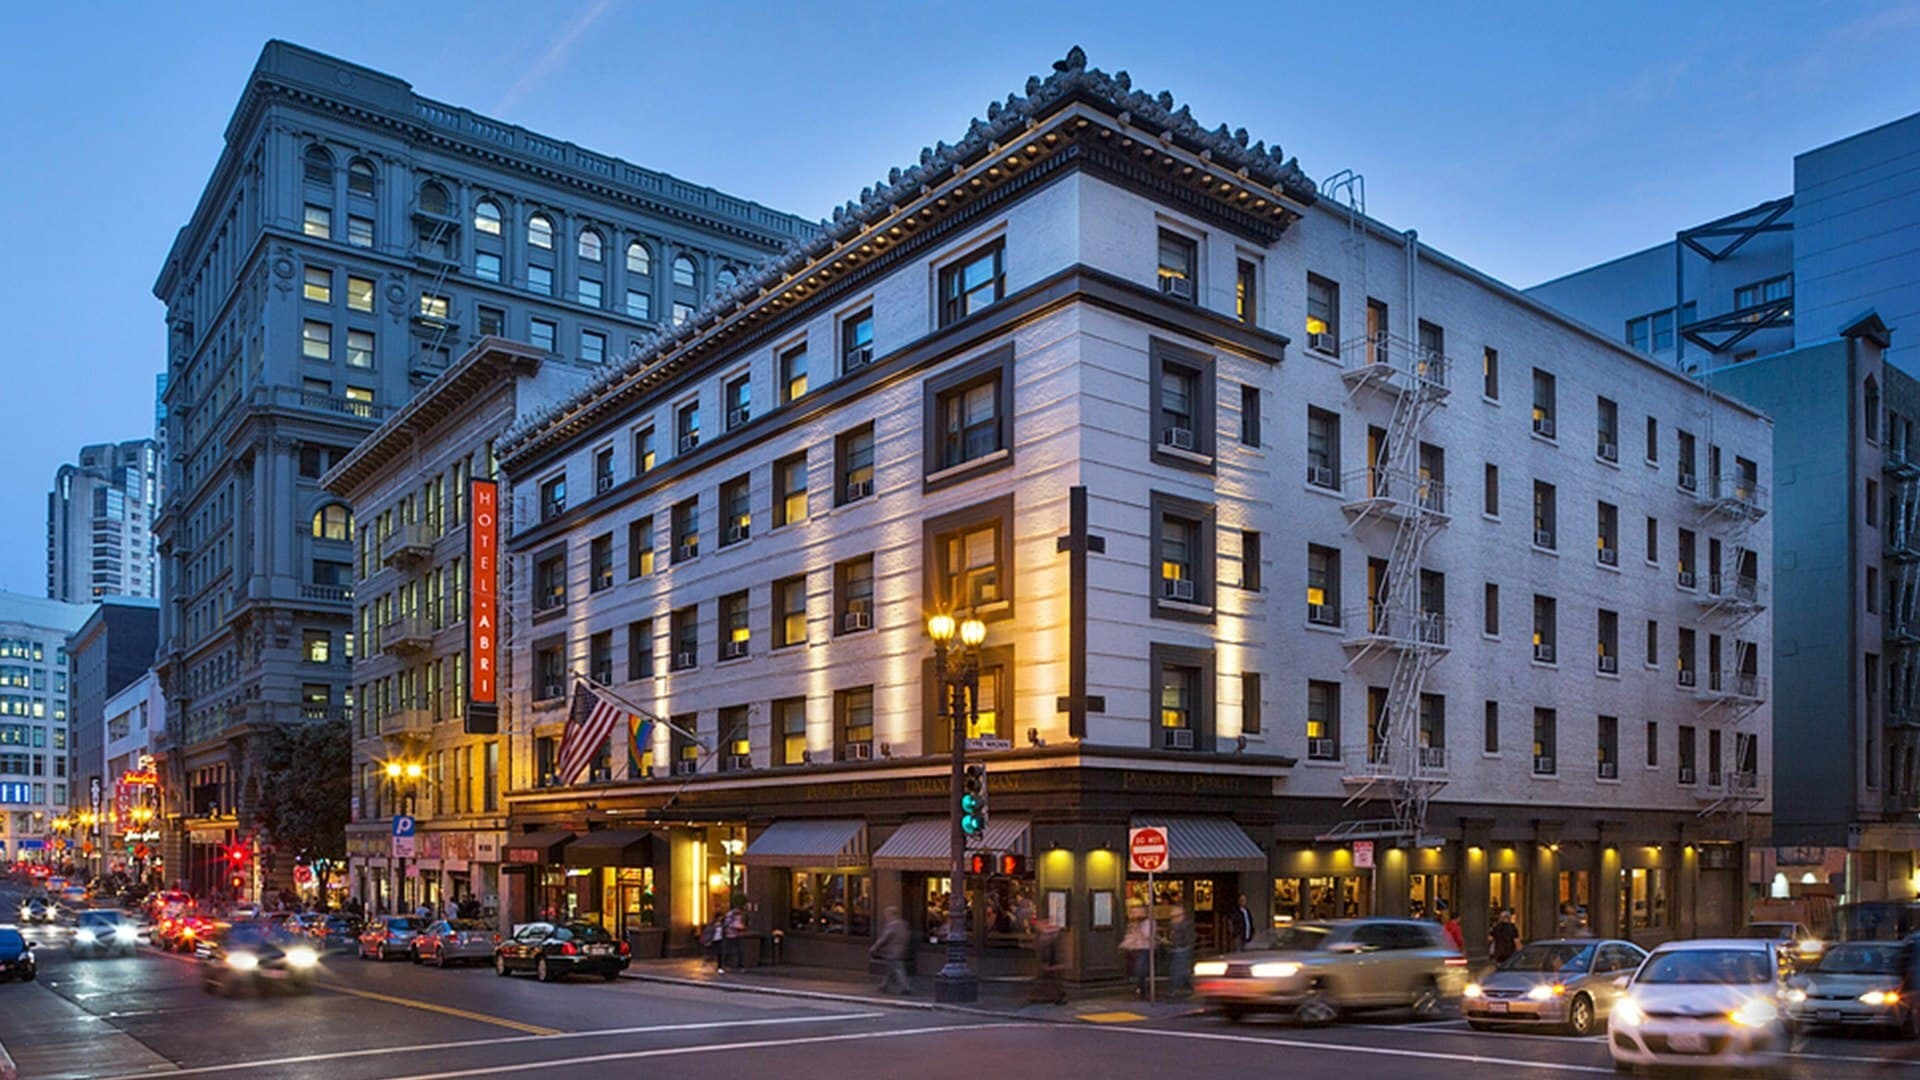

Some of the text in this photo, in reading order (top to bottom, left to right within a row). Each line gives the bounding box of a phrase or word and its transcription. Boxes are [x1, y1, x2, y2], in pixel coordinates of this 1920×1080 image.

[478, 492, 492, 693] HOTEL ABRI
[396, 818, 412, 834] P
